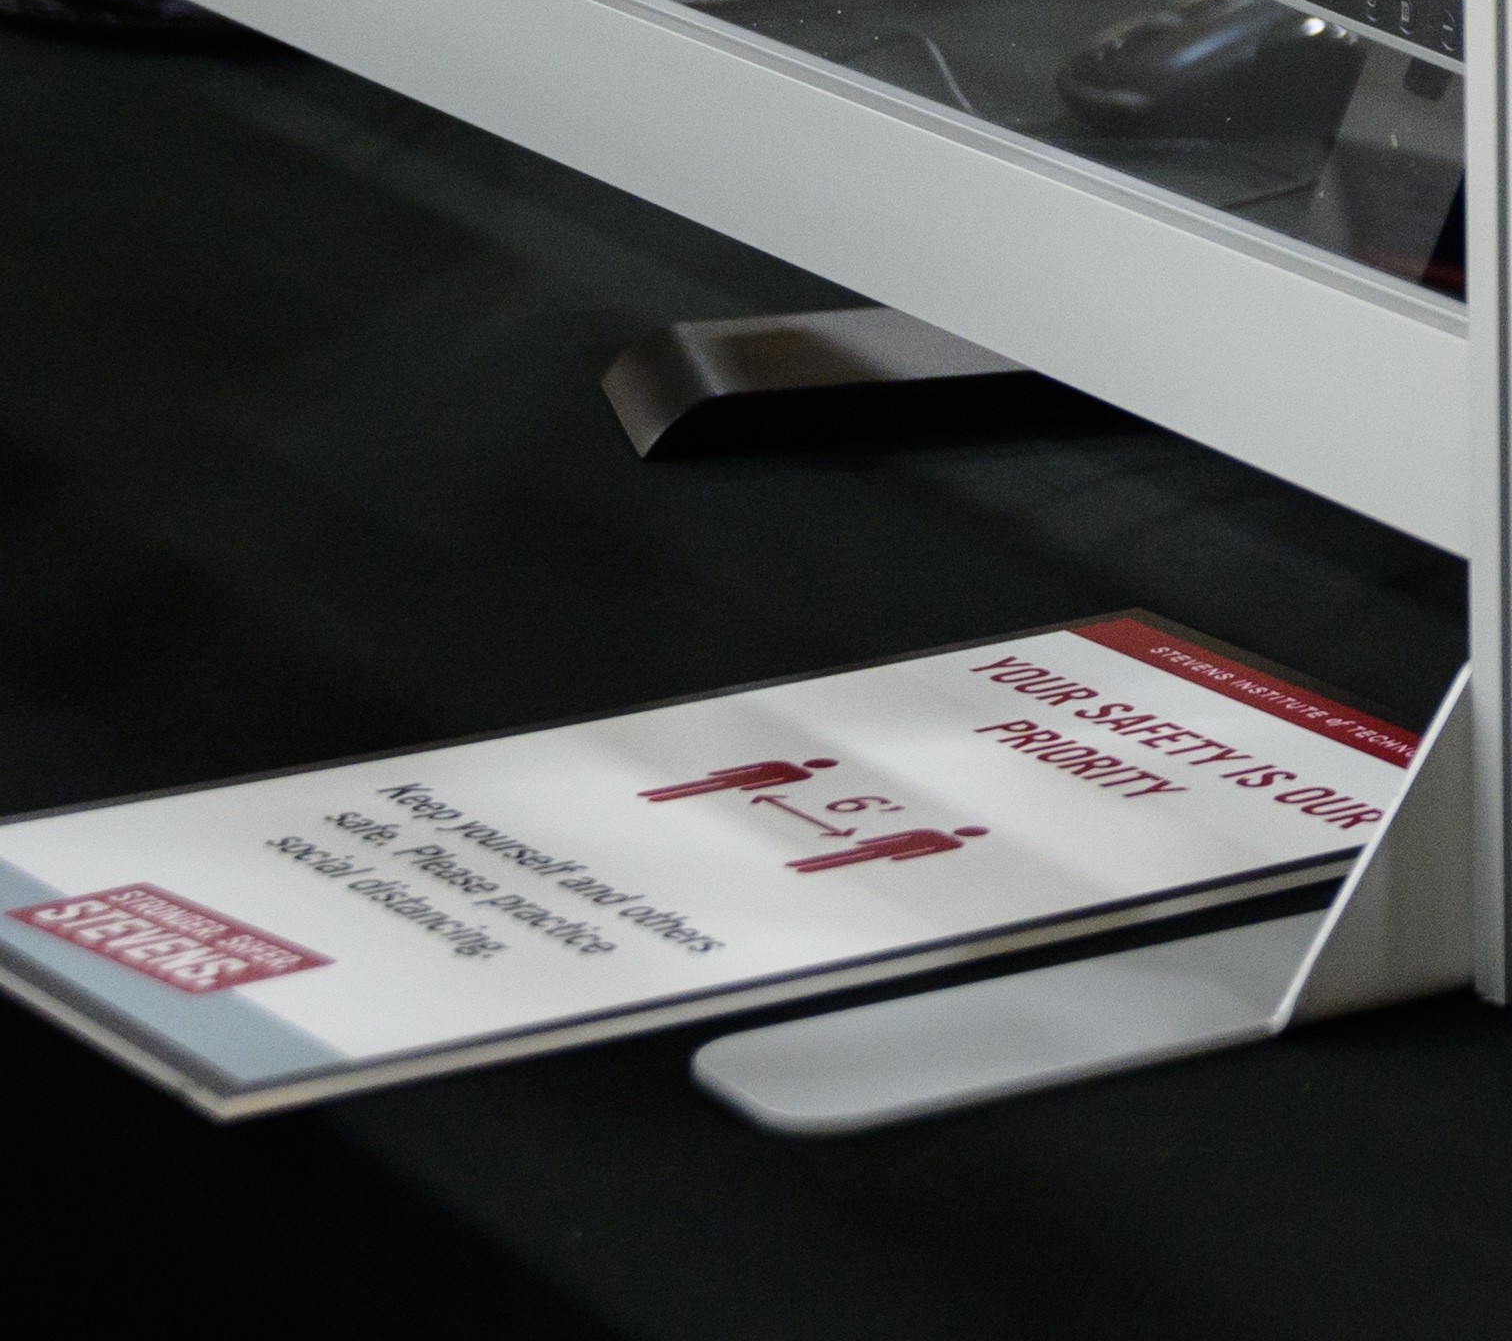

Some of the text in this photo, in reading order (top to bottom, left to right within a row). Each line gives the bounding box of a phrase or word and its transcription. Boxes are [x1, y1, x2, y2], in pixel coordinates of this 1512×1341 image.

[968, 655, 1387, 831] YOUR SAFETY IS OUR
[1148, 645, 1238, 683] STEVENS
[1230, 677, 1330, 720] INSTITUTE
[971, 718, 1191, 800] PRIORITY
[263, 833, 513, 960] social distancing.
[324, 810, 620, 956] safe. Please practice
[374, 781, 729, 956] Keep yourself and others
